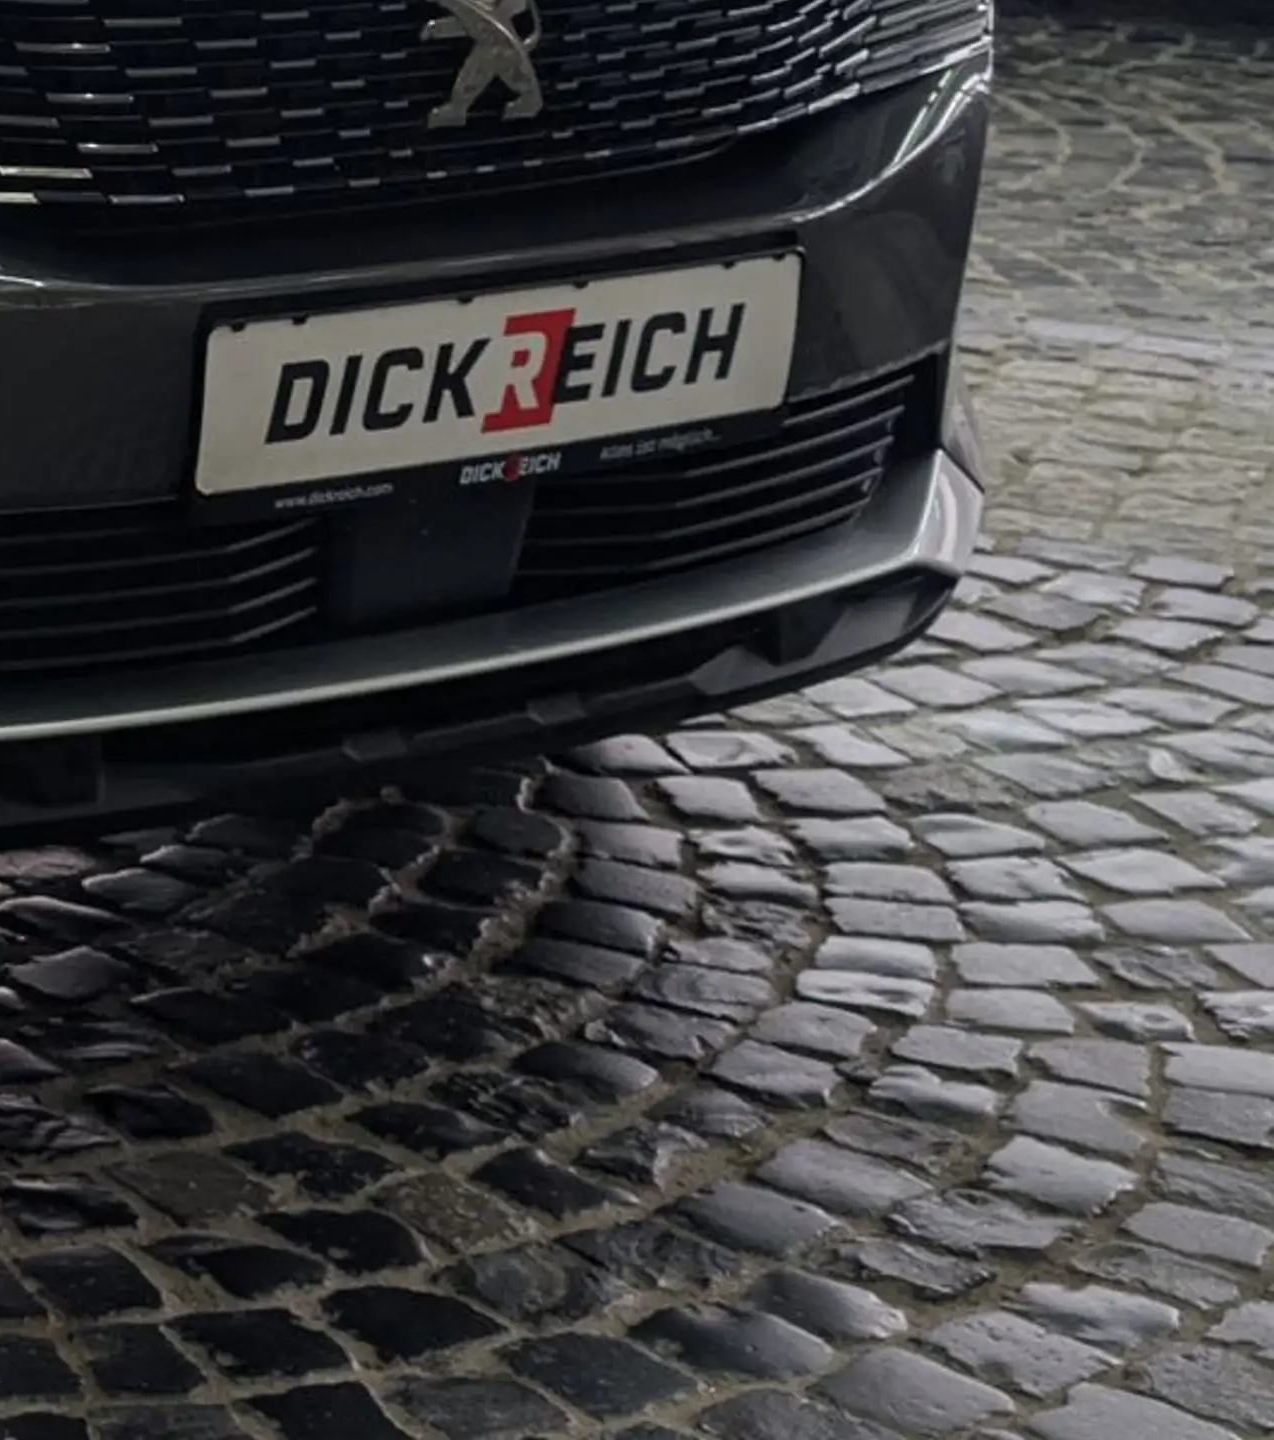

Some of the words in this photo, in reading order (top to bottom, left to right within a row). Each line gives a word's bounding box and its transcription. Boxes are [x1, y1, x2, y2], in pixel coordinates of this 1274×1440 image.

[264, 302, 746, 444] DICKREICH
[459, 450, 563, 485] DICKEICH
[274, 481, 394, 509] www.dickreich.com
